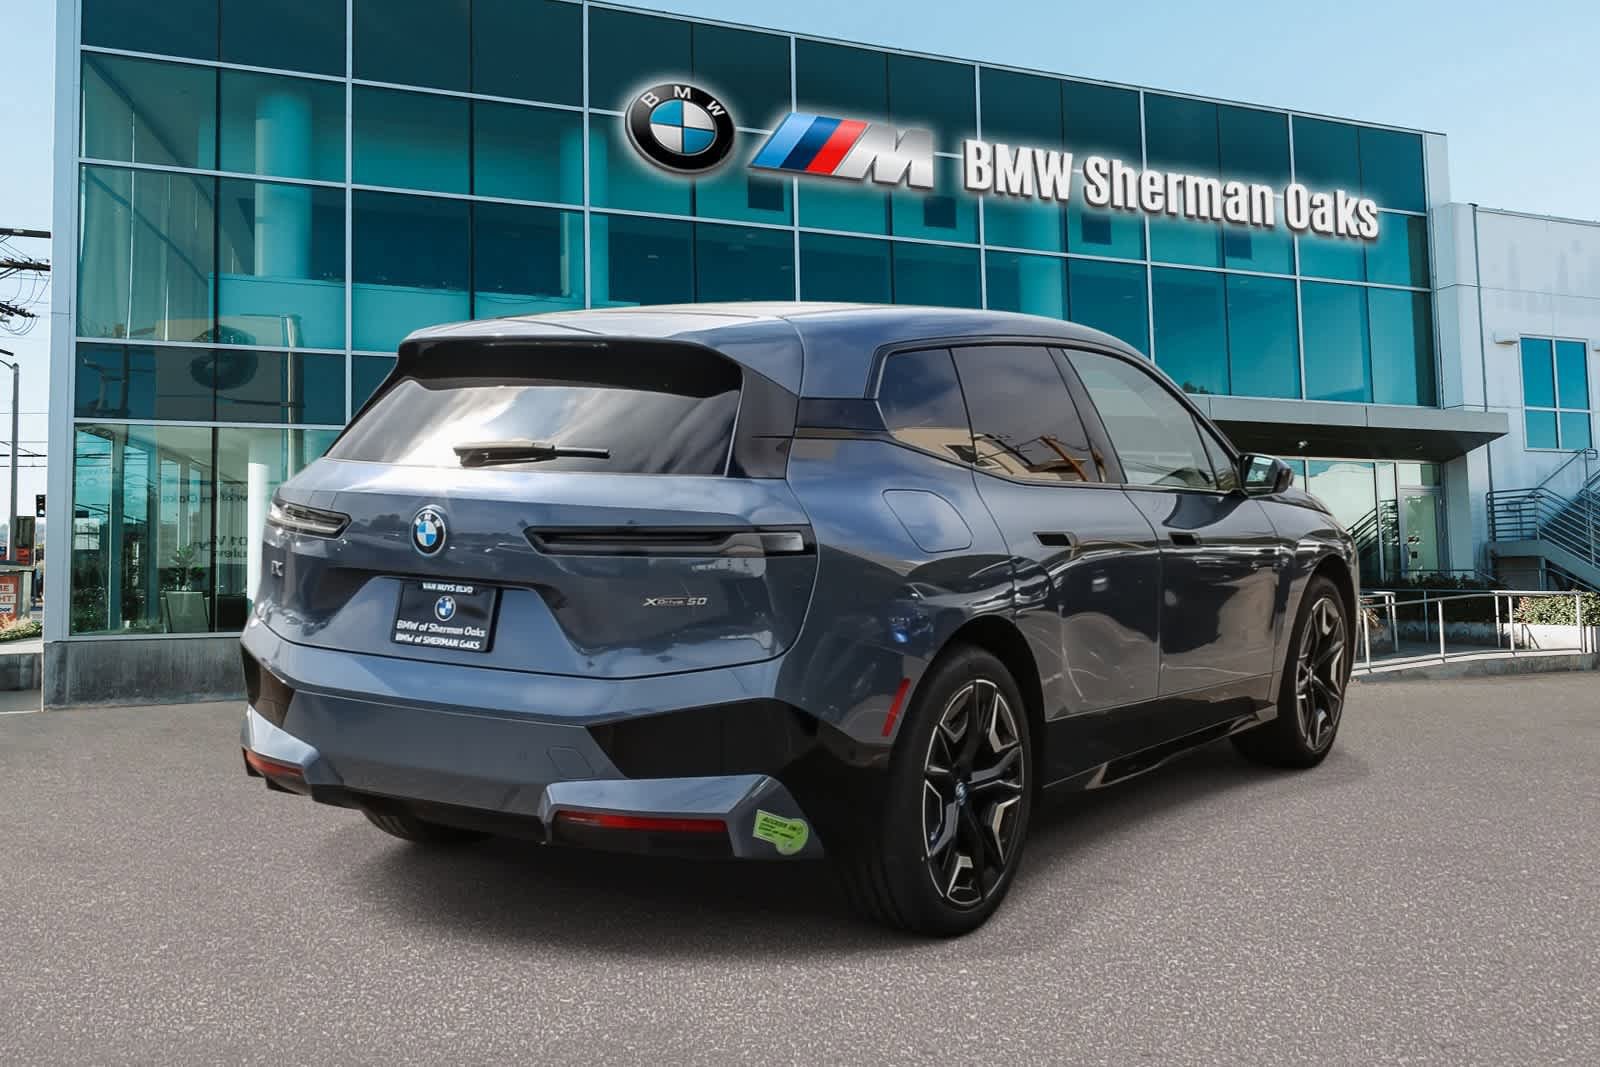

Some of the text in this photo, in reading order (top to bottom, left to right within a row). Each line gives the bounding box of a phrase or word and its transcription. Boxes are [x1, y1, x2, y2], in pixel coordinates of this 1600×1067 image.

[640, 85, 725, 117] BMW
[963, 139, 1379, 240] BMW Sherman Oaks
[397, 619, 486, 638] BMW of Sherman Oaks
